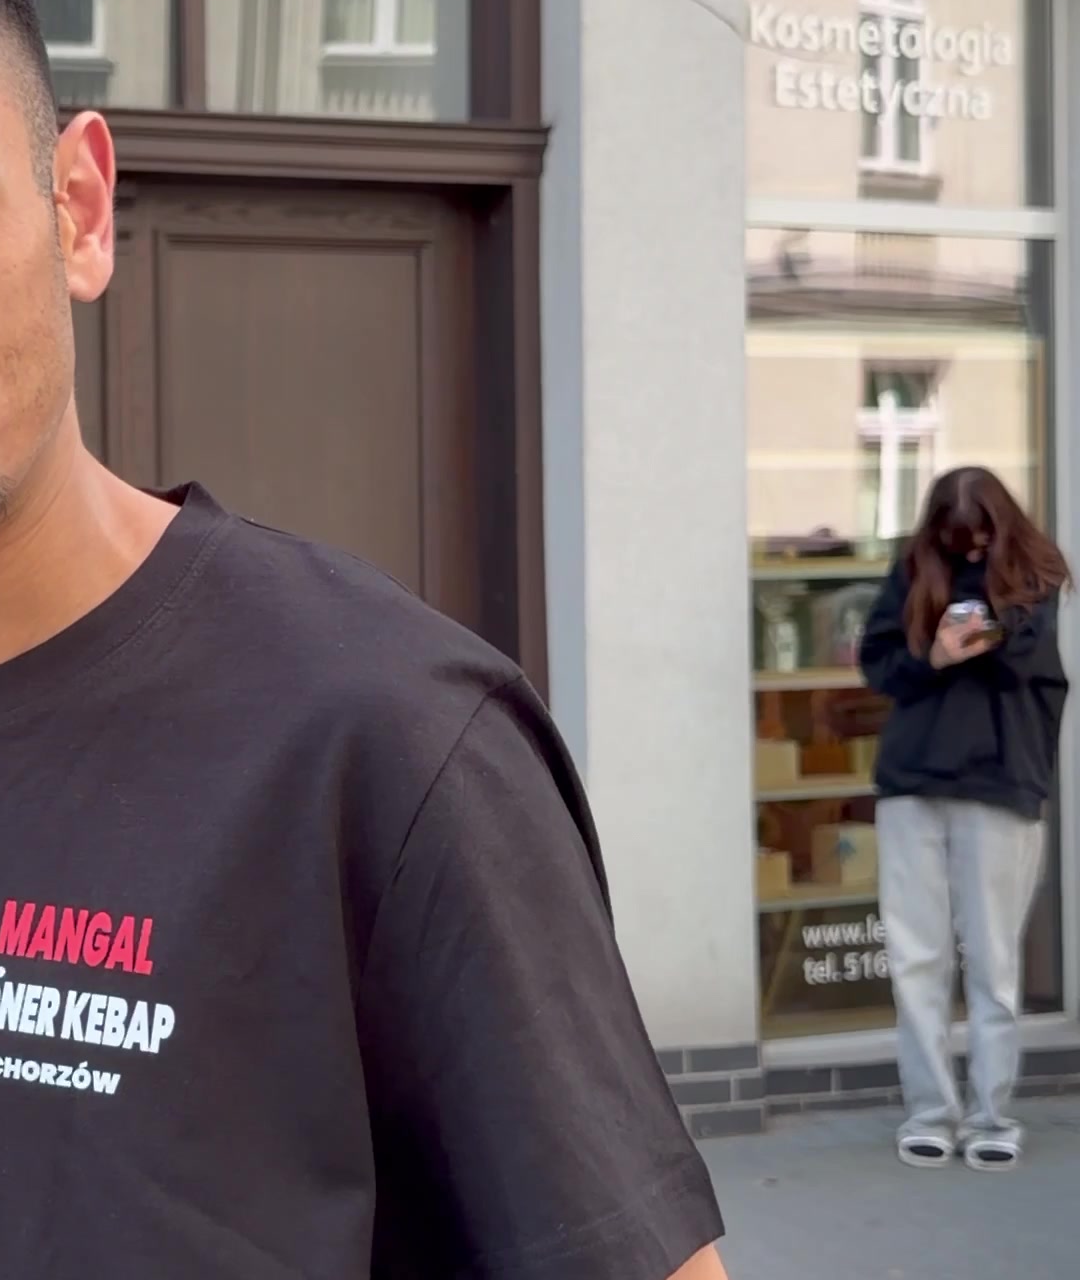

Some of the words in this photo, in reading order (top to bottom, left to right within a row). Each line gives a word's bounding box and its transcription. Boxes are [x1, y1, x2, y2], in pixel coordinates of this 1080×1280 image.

[748, 0, 1015, 77] Kosmetologia
[774, 58, 994, 126] Estetyczna
[60, 990, 176, 1054] KEBAP
